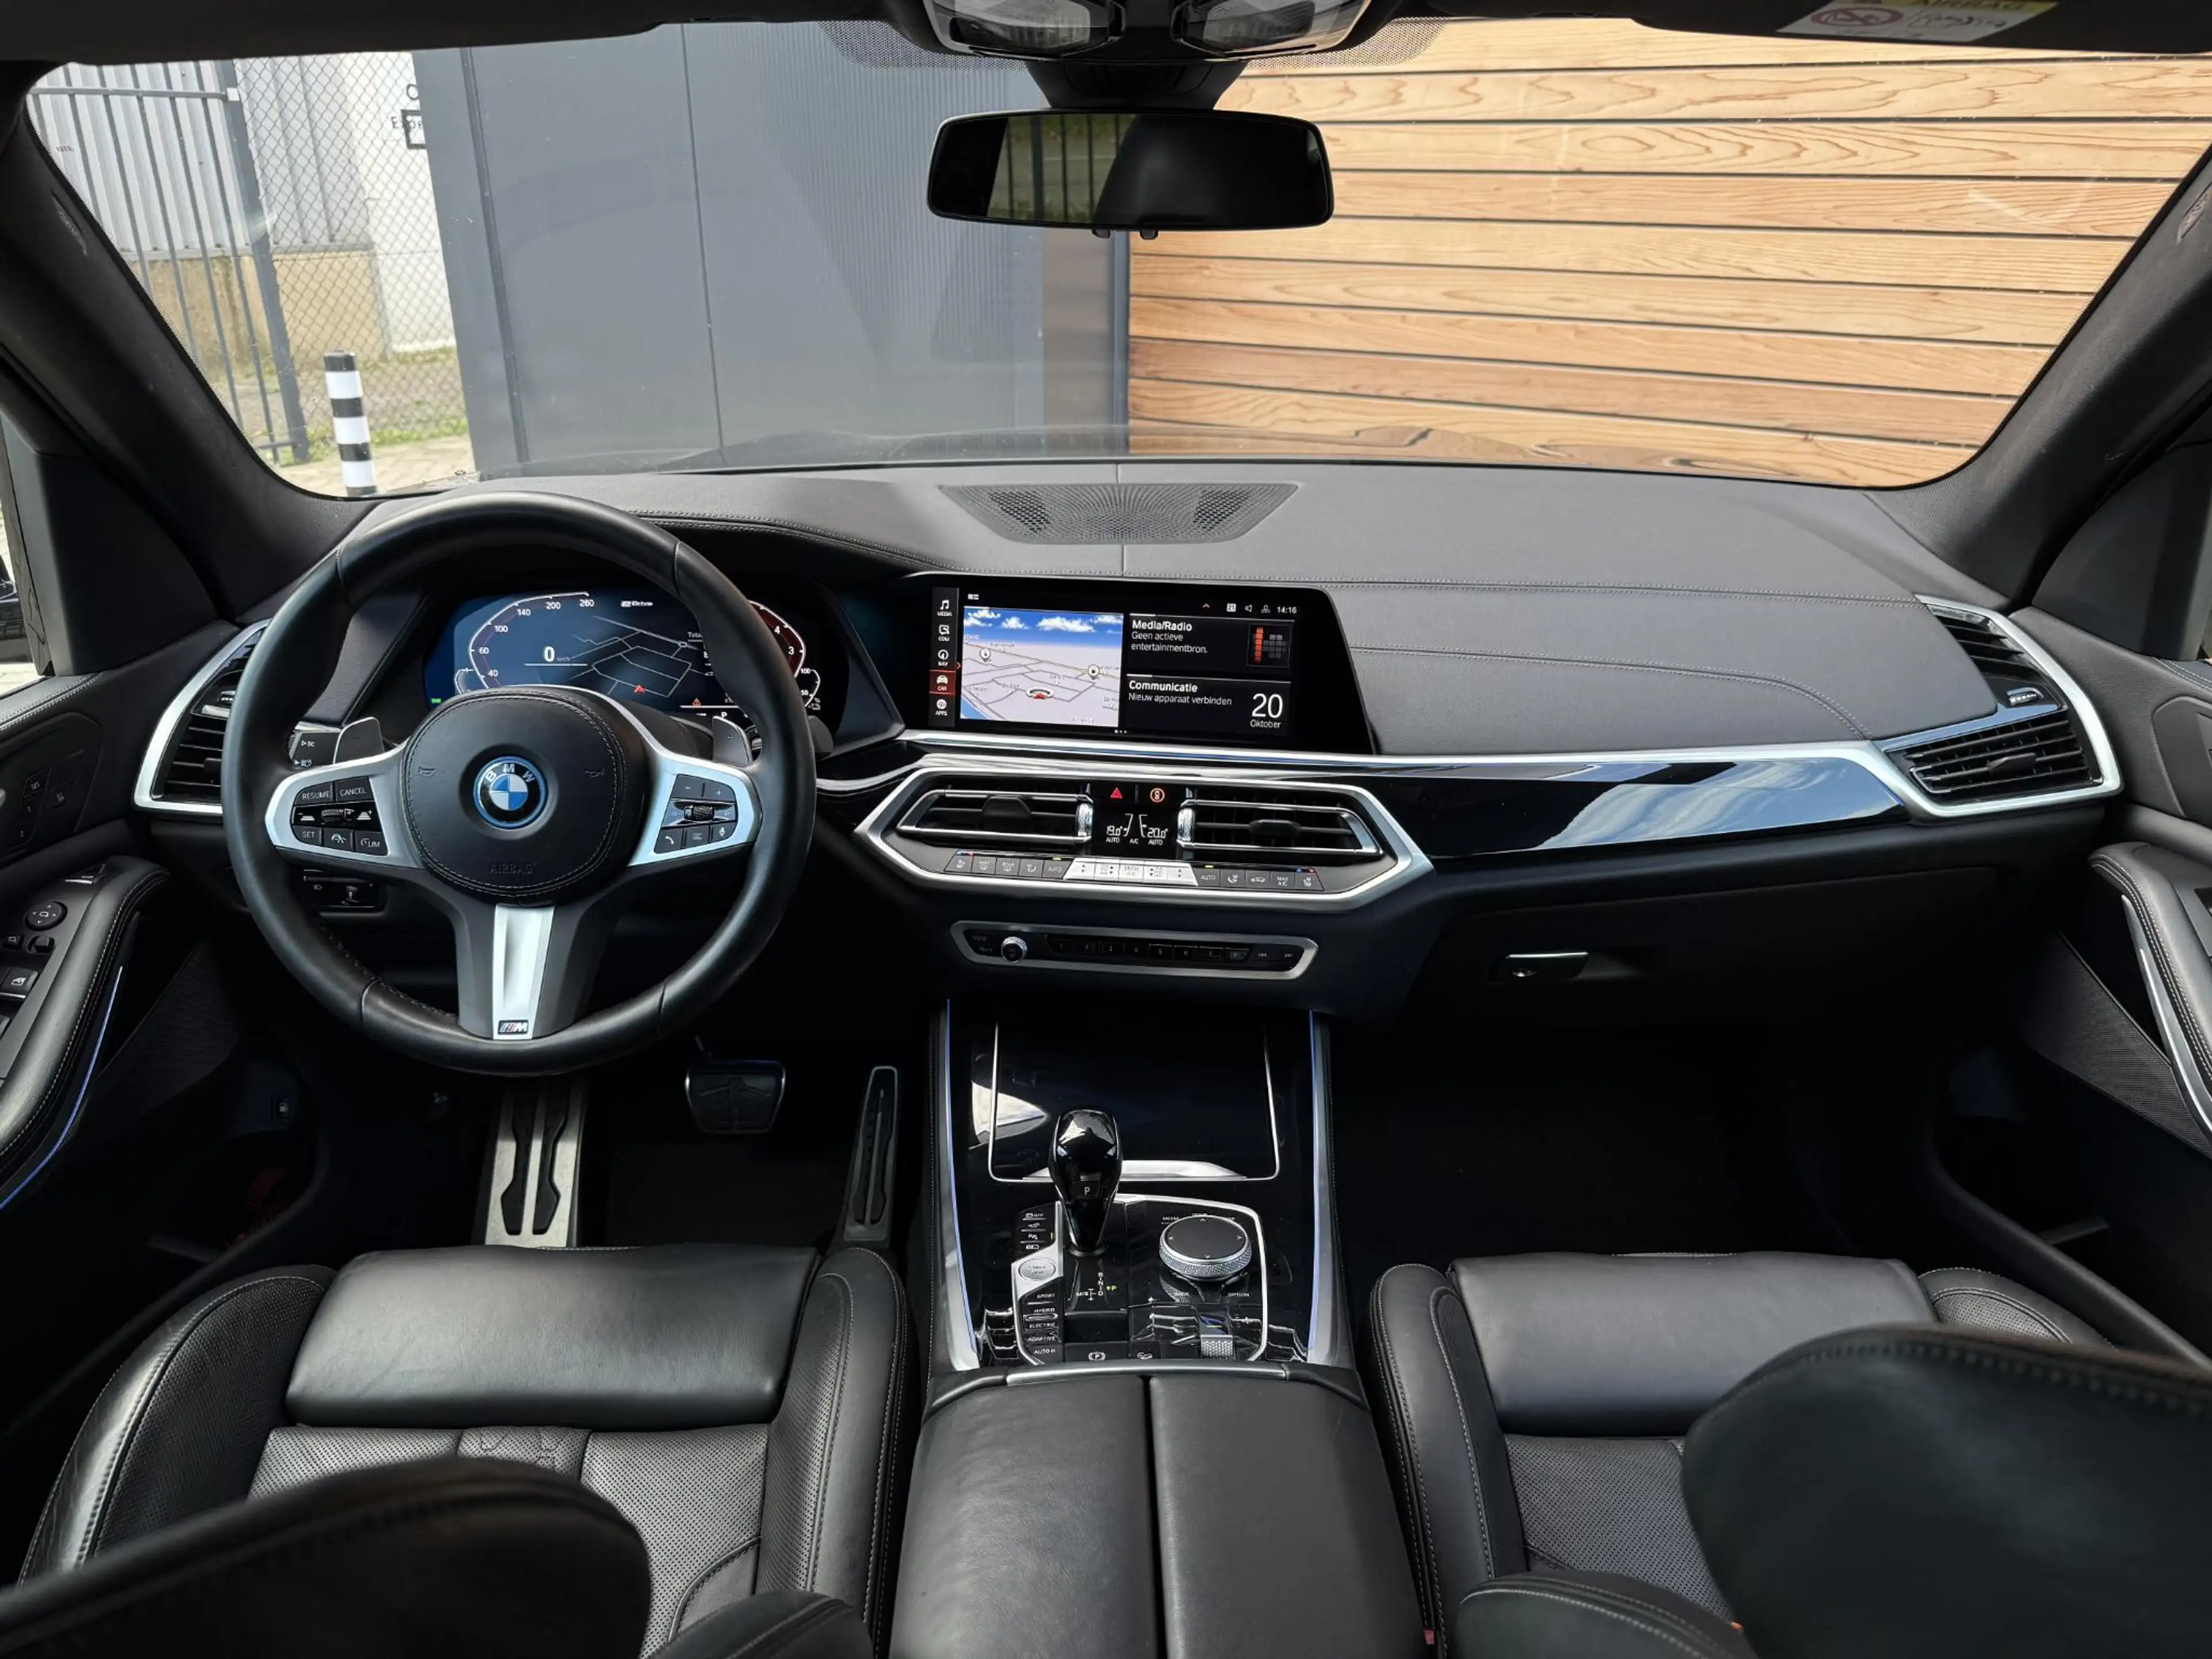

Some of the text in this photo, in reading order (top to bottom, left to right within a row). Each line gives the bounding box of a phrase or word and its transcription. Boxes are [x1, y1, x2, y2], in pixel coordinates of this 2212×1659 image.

[1277, 606, 1297, 614] 14:16
[774, 626, 780, 634] 4
[1132, 619, 1192, 631] Media/Radio
[1131, 631, 1183, 641] Geen actieve
[788, 646, 794, 655] 3
[1131, 643, 1208, 653] entertainmentbron.
[544, 646, 555, 662] 0
[1129, 680, 1198, 692] Communicatie
[1128, 693, 1152, 701] Nieuw
[1154, 695, 1190, 704] apparaat
[1191, 696, 1232, 706] verbinden
[1252, 693, 1283, 718] 20
[1250, 719, 1281, 729] Oktober
[485, 763, 536, 783] BMW
[302, 790, 330, 800] RESUME
[340, 787, 367, 796] CANCEL
[1084, 1187, 1091, 1196] P
